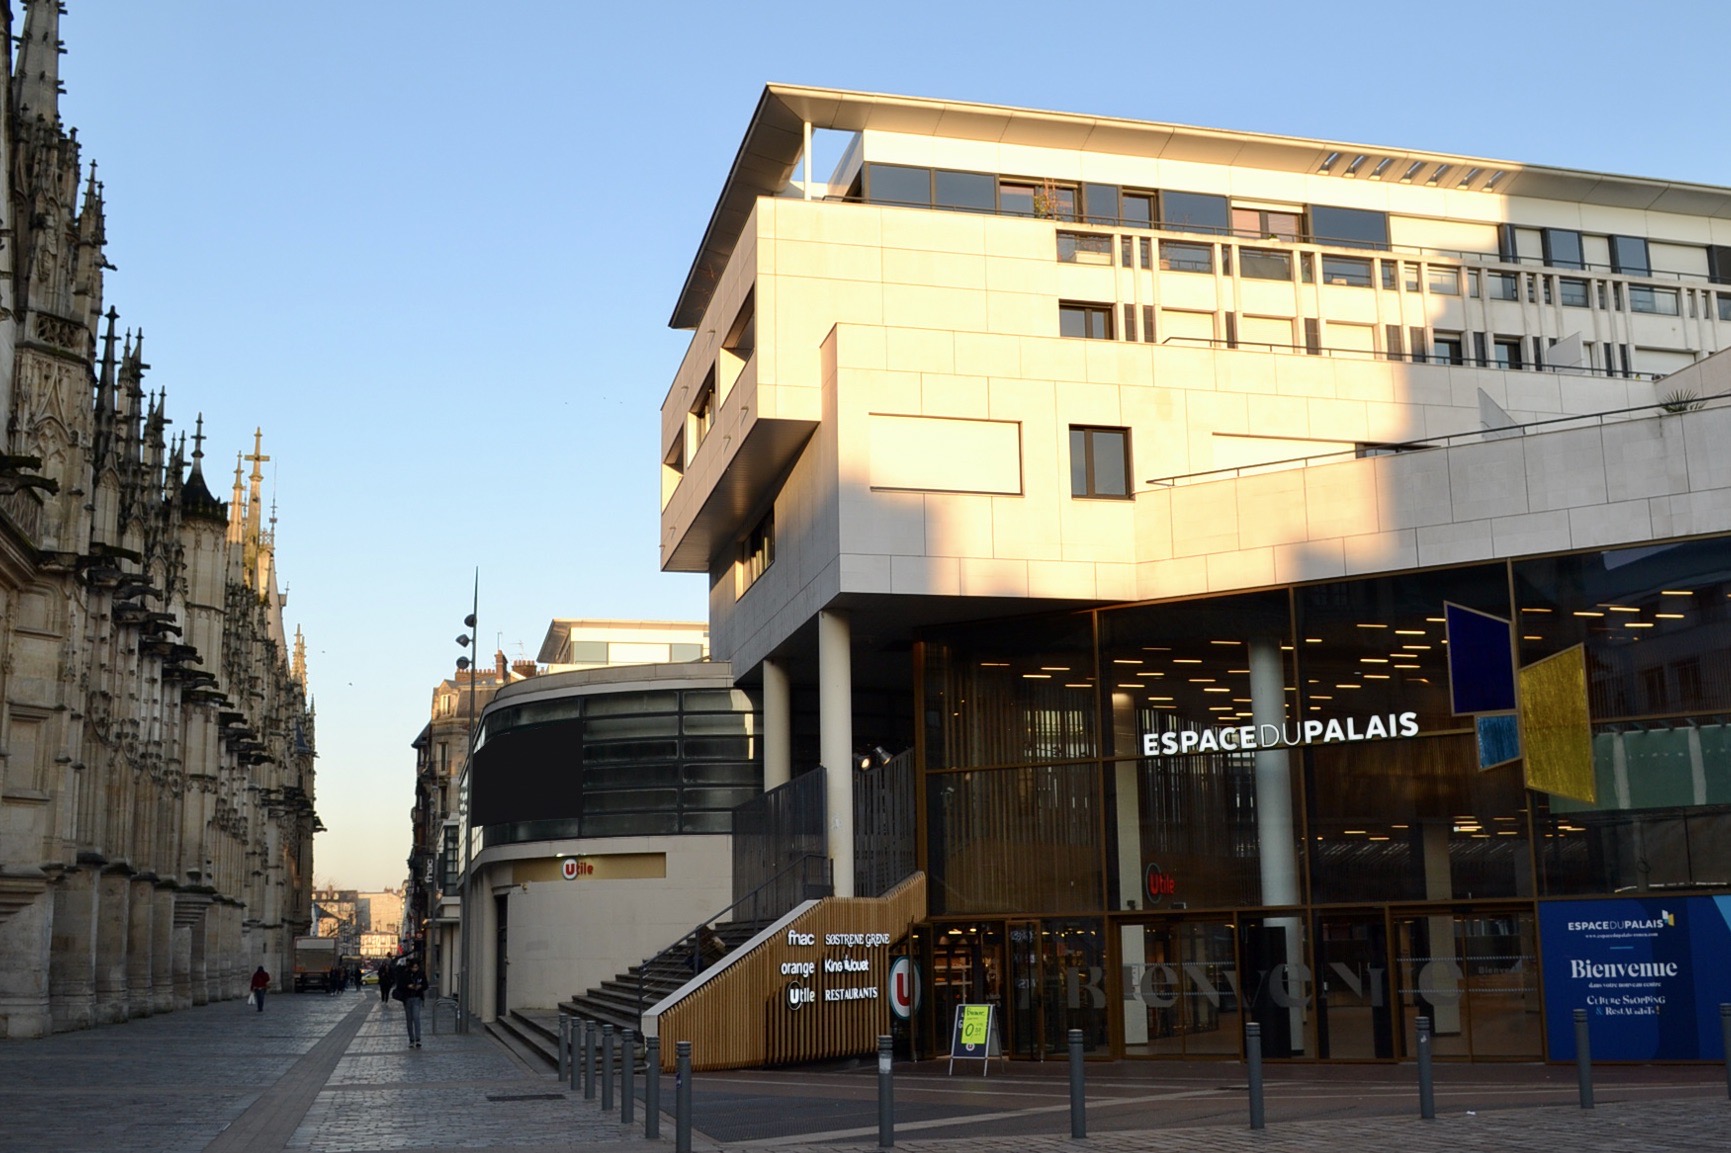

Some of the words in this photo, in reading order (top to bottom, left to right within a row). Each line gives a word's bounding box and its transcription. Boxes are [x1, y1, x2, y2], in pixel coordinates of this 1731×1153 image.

[425, 858, 434, 883] fnac
[565, 862, 593, 876] Utile
[788, 929, 815, 945] fnac
[865, 933, 890, 948] GRENE
[781, 962, 815, 978] orange
[1570, 959, 1678, 978] Bienvenue
[790, 987, 815, 1003] Utile
[825, 987, 878, 1001] RESTAURANTS
